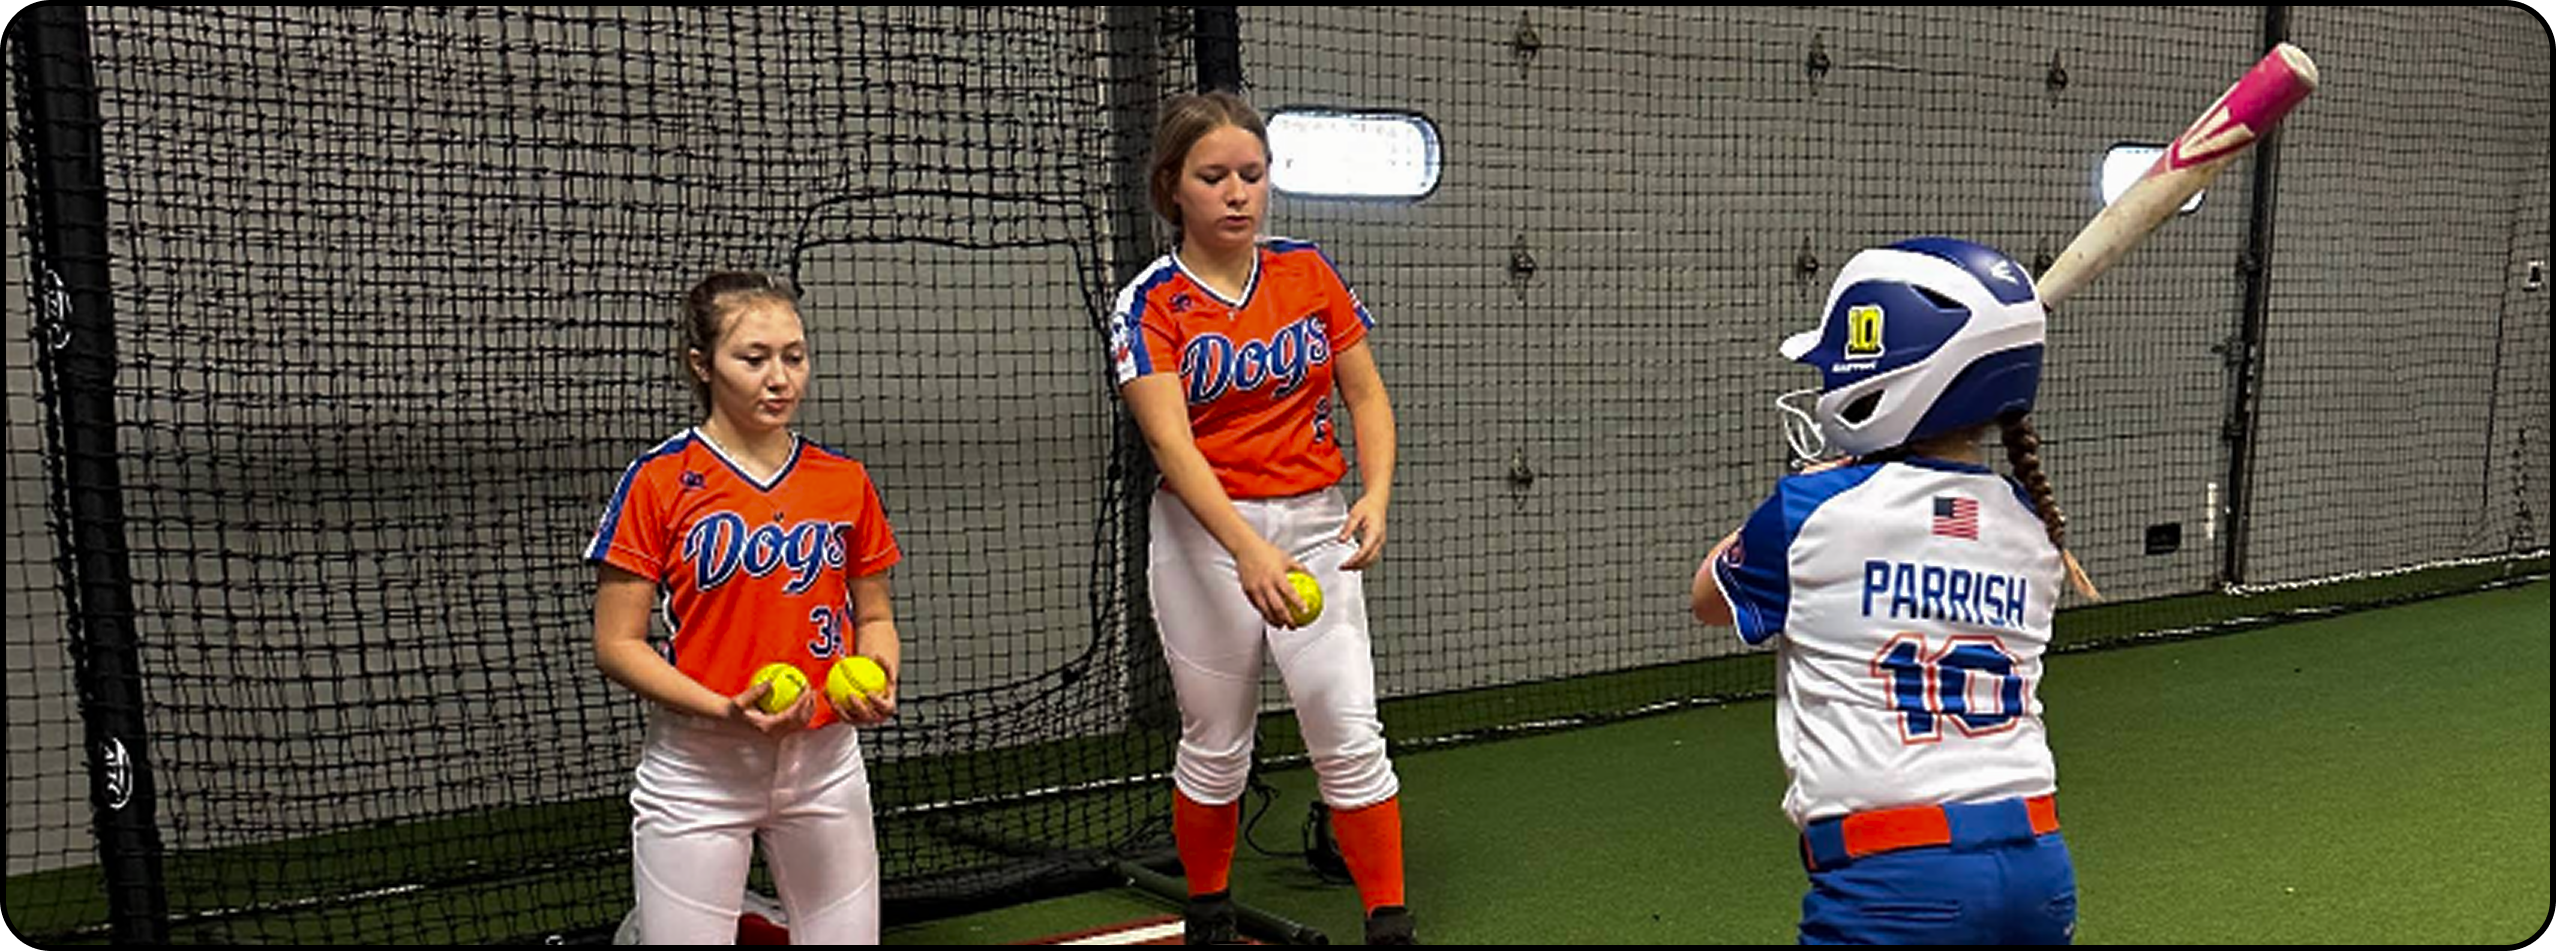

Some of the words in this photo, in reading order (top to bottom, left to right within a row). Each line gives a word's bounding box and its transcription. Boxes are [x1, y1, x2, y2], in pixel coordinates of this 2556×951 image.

[1180, 312, 1330, 406] Dogs
[1845, 305, 1885, 360] 10
[683, 511, 853, 594] Dogs
[1861, 559, 2028, 631] PARRISH
[1871, 632, 2030, 745] 10
